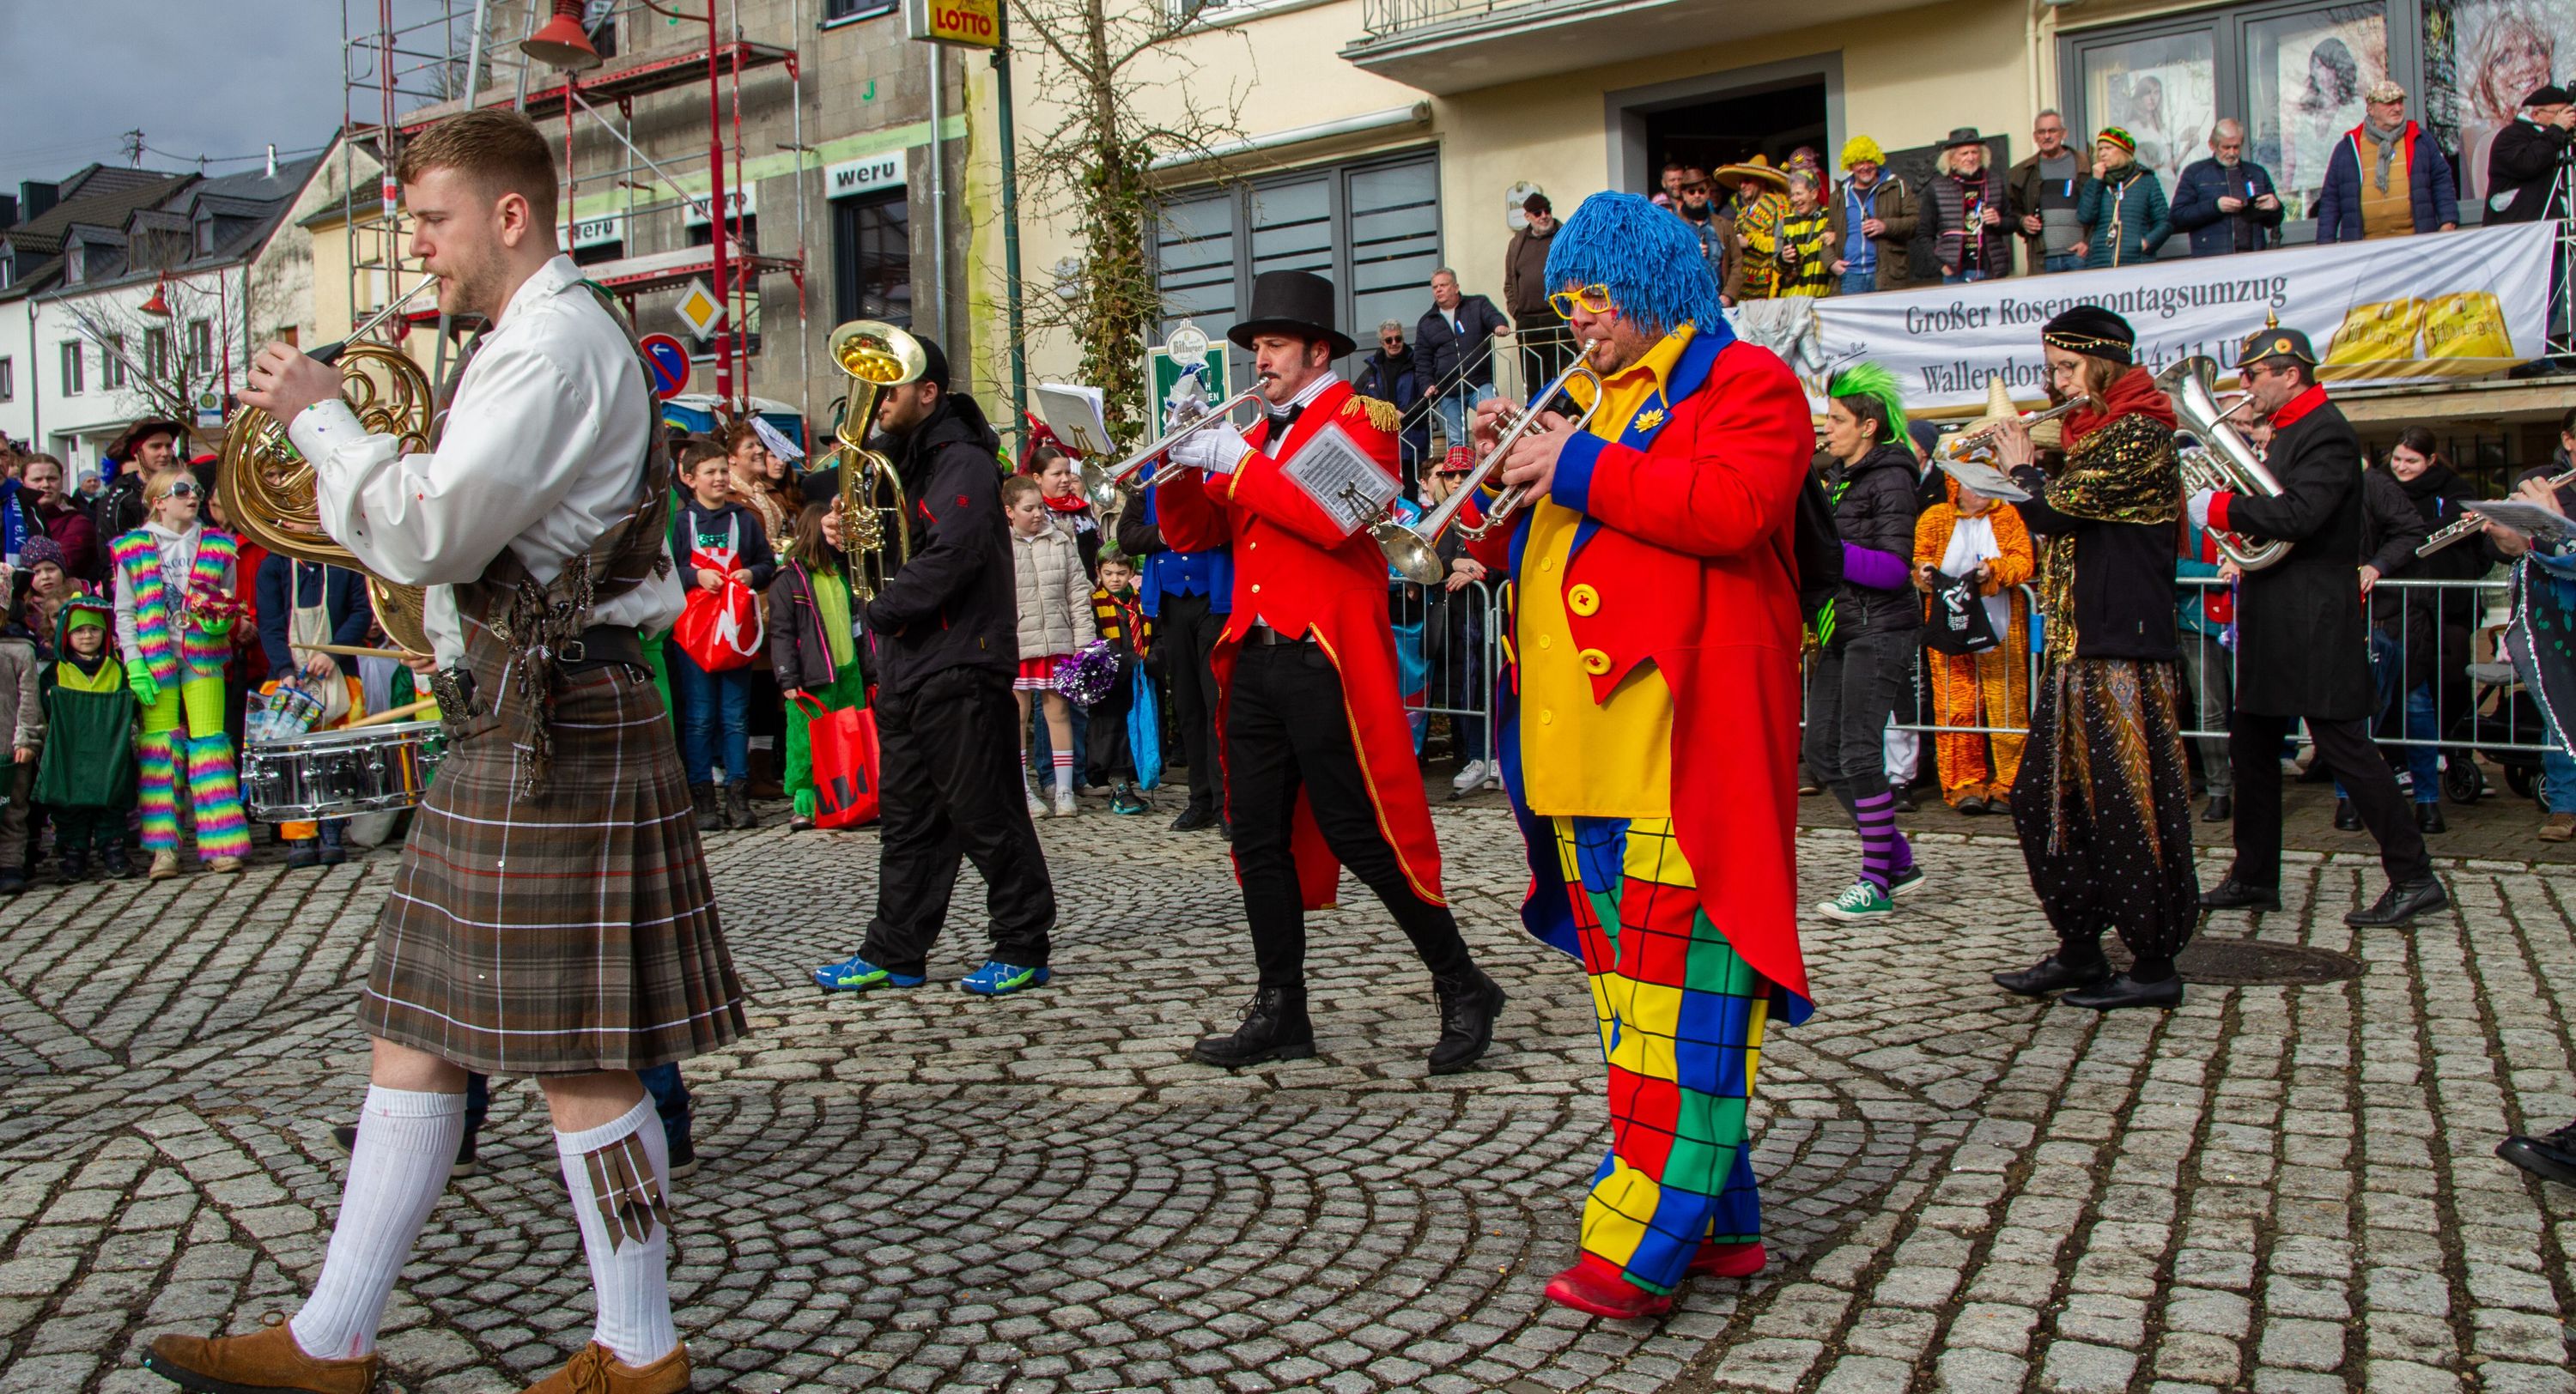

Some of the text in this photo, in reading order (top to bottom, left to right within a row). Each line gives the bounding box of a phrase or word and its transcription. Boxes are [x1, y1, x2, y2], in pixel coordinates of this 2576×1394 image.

[937, 7, 992, 37] LOTTO
[862, 82, 875, 100] J
[836, 161, 895, 187] weru
[1905, 276, 2287, 335] Großer Rosenmontagsumzug
[1173, 340, 1204, 355] Bitburger
[1920, 356, 2044, 394] Wallendor
